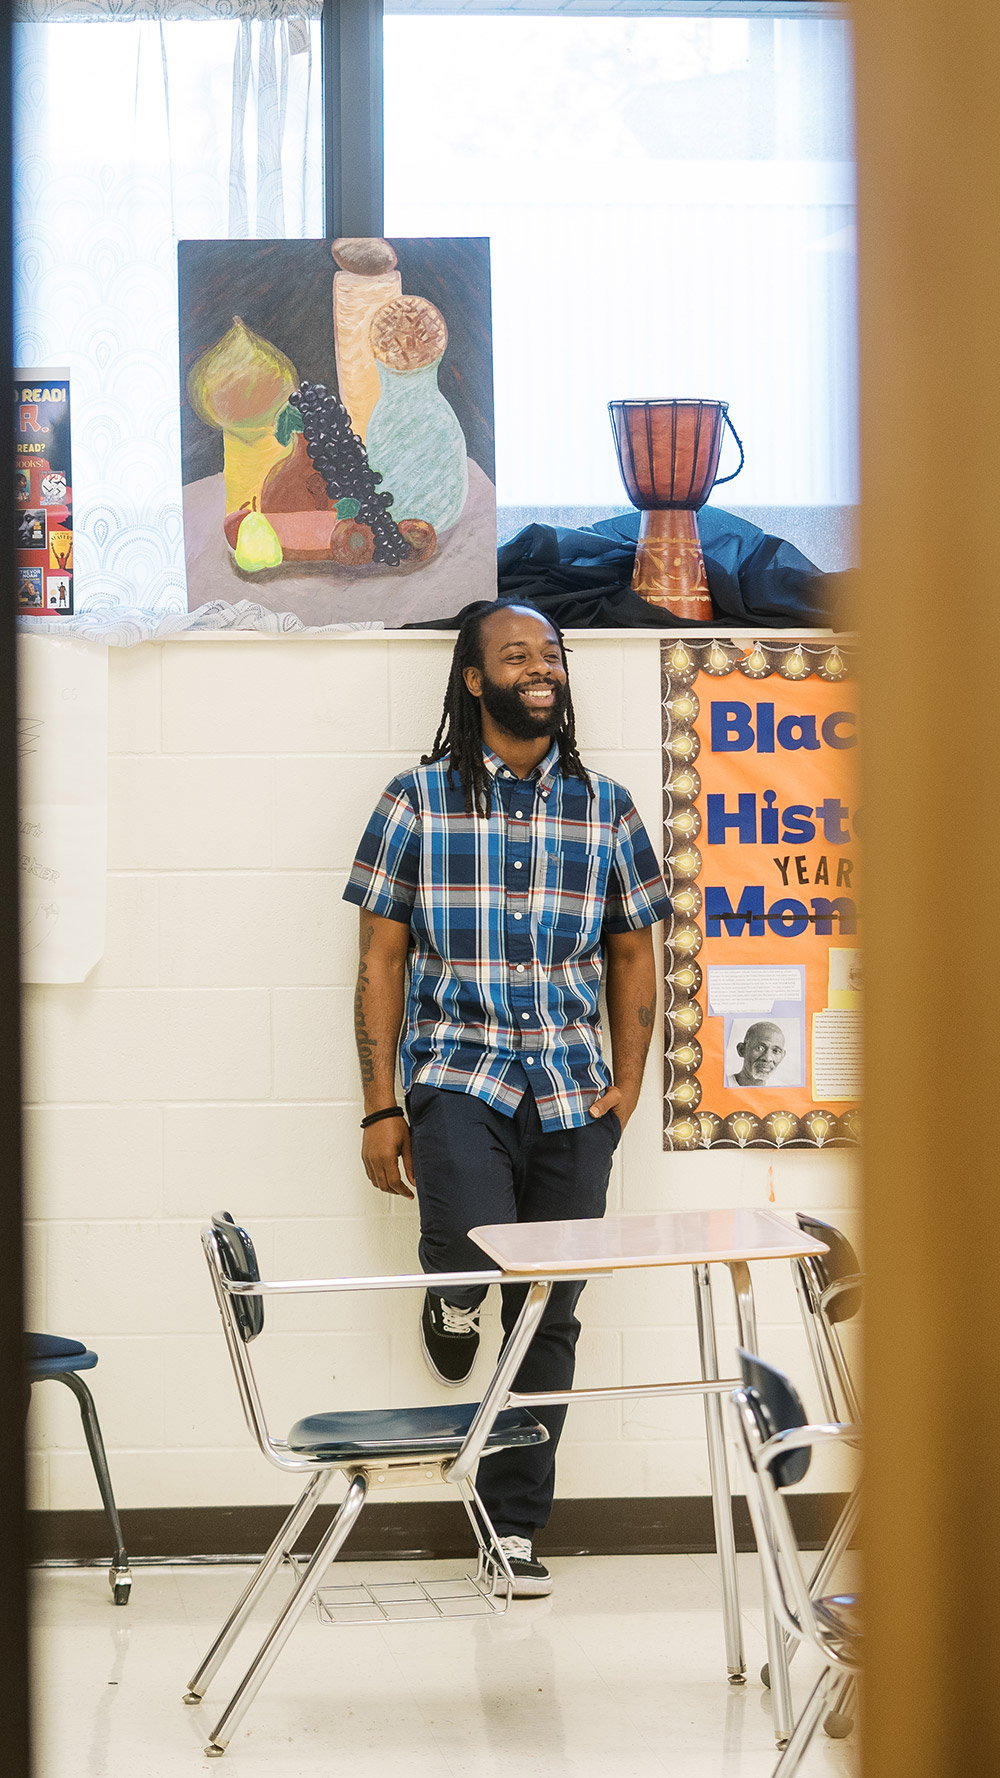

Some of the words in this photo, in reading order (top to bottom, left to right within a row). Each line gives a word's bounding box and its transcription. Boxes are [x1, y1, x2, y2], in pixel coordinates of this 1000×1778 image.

[21, 388, 67, 402] READ!
[17, 443, 46, 453] READ?
[710, 701, 858, 753] Blac
[773, 855, 854, 888] YEAR
